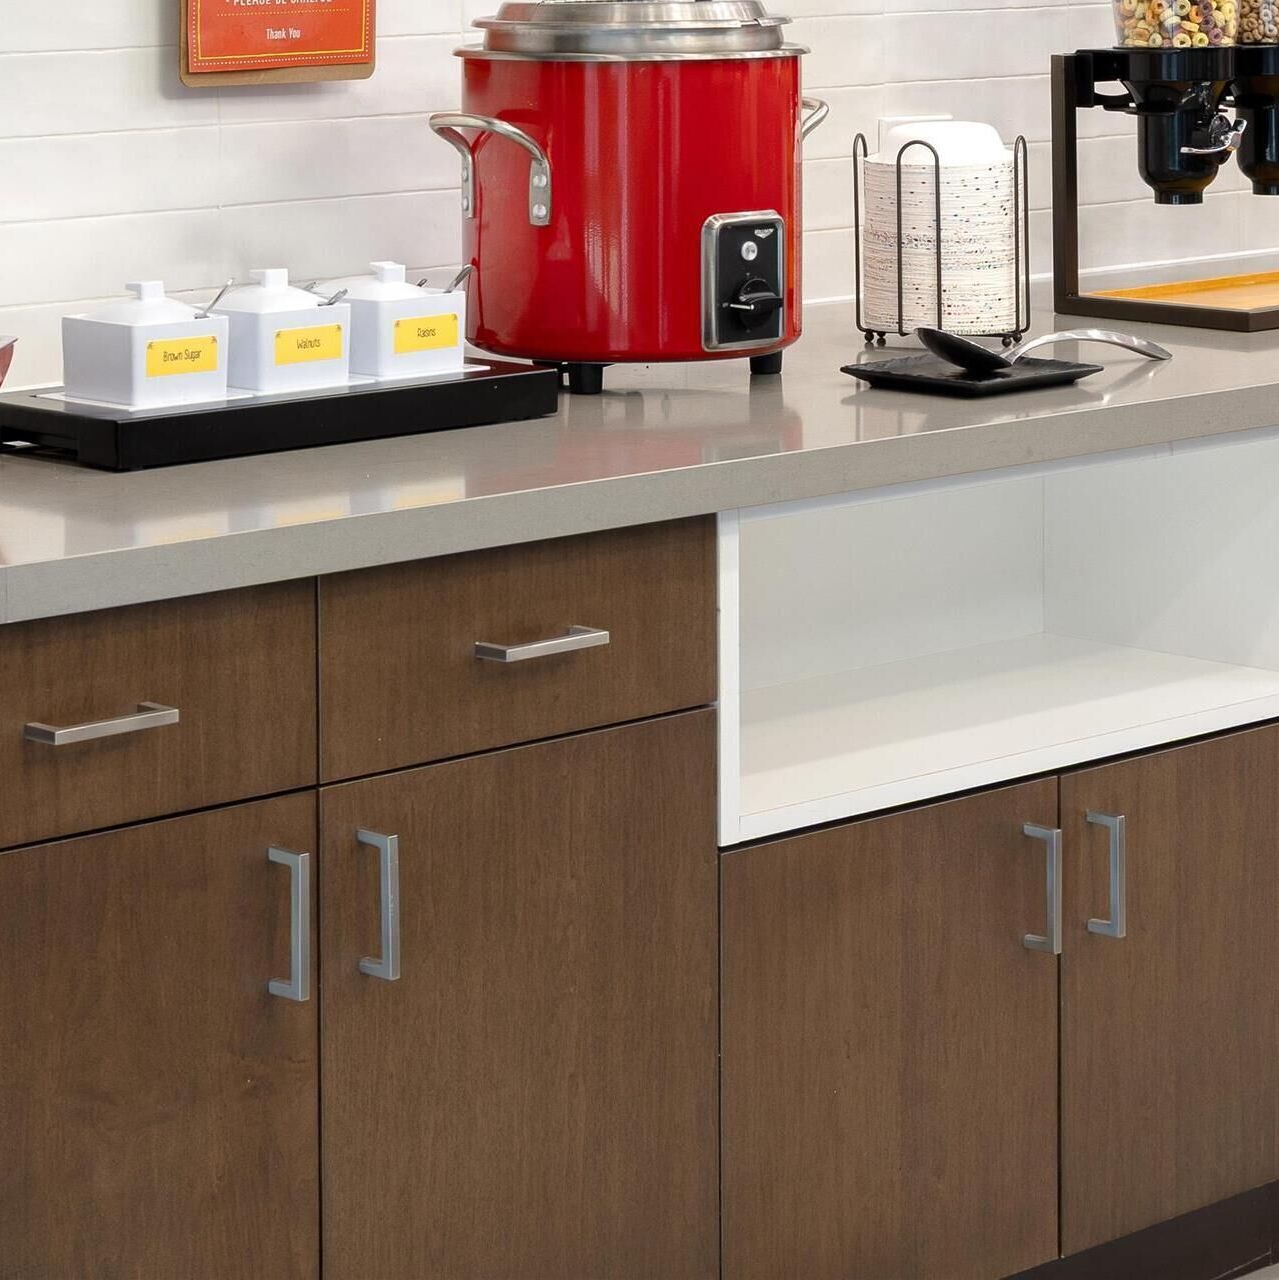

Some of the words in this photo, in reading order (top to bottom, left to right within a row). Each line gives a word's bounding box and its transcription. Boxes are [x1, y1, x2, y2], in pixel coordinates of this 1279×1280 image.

[265, 27, 287, 40] Thank
[288, 27, 301, 39] You
[296, 337, 321, 350] Walnuts
[162, 350, 183, 362] Brown
[184, 348, 202, 362] Sugar
